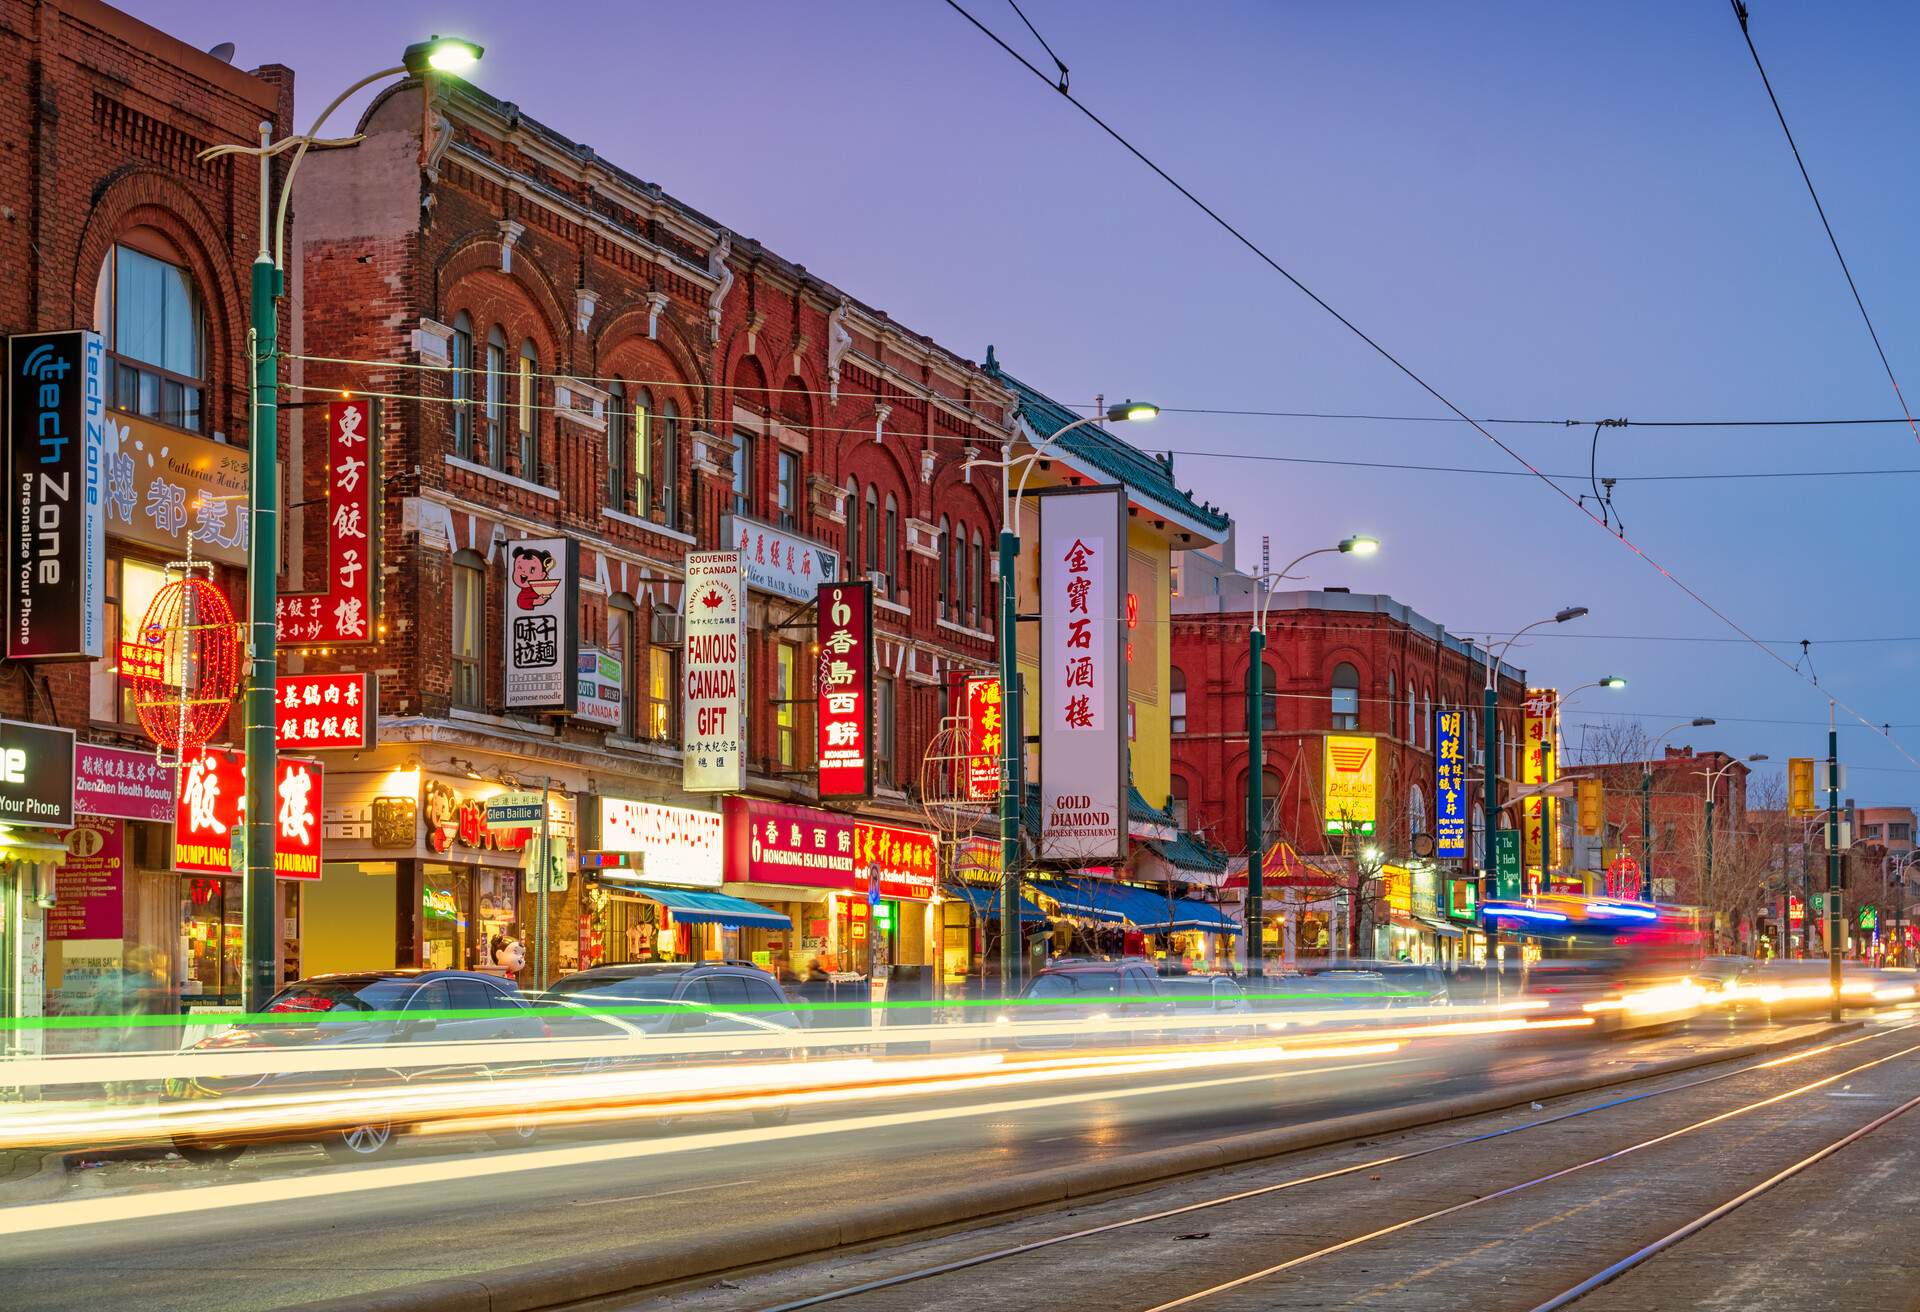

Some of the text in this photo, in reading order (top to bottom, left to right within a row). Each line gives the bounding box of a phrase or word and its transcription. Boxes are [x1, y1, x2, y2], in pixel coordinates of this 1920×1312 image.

[88, 340, 102, 415] tech
[39, 356, 70, 584] tech Zone
[88, 420, 102, 505] Zone
[168, 457, 213, 482] Catherine
[216, 472, 239, 490] Hair
[333, 406, 366, 637] 東方餃子樓
[21, 472, 33, 645] Personalize Your Phone
[690, 554, 737, 563] SOUVENIRS
[703, 566, 737, 574] CANADA
[747, 564, 764, 584] lice
[689, 584, 704, 614] FAMOUS
[706, 580, 732, 594] CANADA
[1064, 538, 1095, 729] 金寶石酒樓
[688, 634, 736, 664] FAMOUS
[578, 682, 594, 696] OOTS
[688, 670, 736, 700] CANADA
[588, 703, 612, 718] CANADA
[698, 707, 727, 736] GIFT
[77, 777, 171, 804] ZhenZhen Health Beauty
[26, 798, 60, 816] Phone
[488, 809, 504, 819] Glen
[507, 808, 531, 818] Baillie
[1057, 796, 1090, 809] GOLD
[1051, 812, 1110, 826] DIAMOND
[1075, 828, 1117, 837] RESTAURANT
[1503, 838, 1512, 848] The
[176, 844, 317, 873] DUMPLING STAURANT
[763, 849, 853, 871] HONGKONG ISLAND BAKERY
[1503, 853, 1516, 864] Herb
[1503, 870, 1519, 881] Depot
